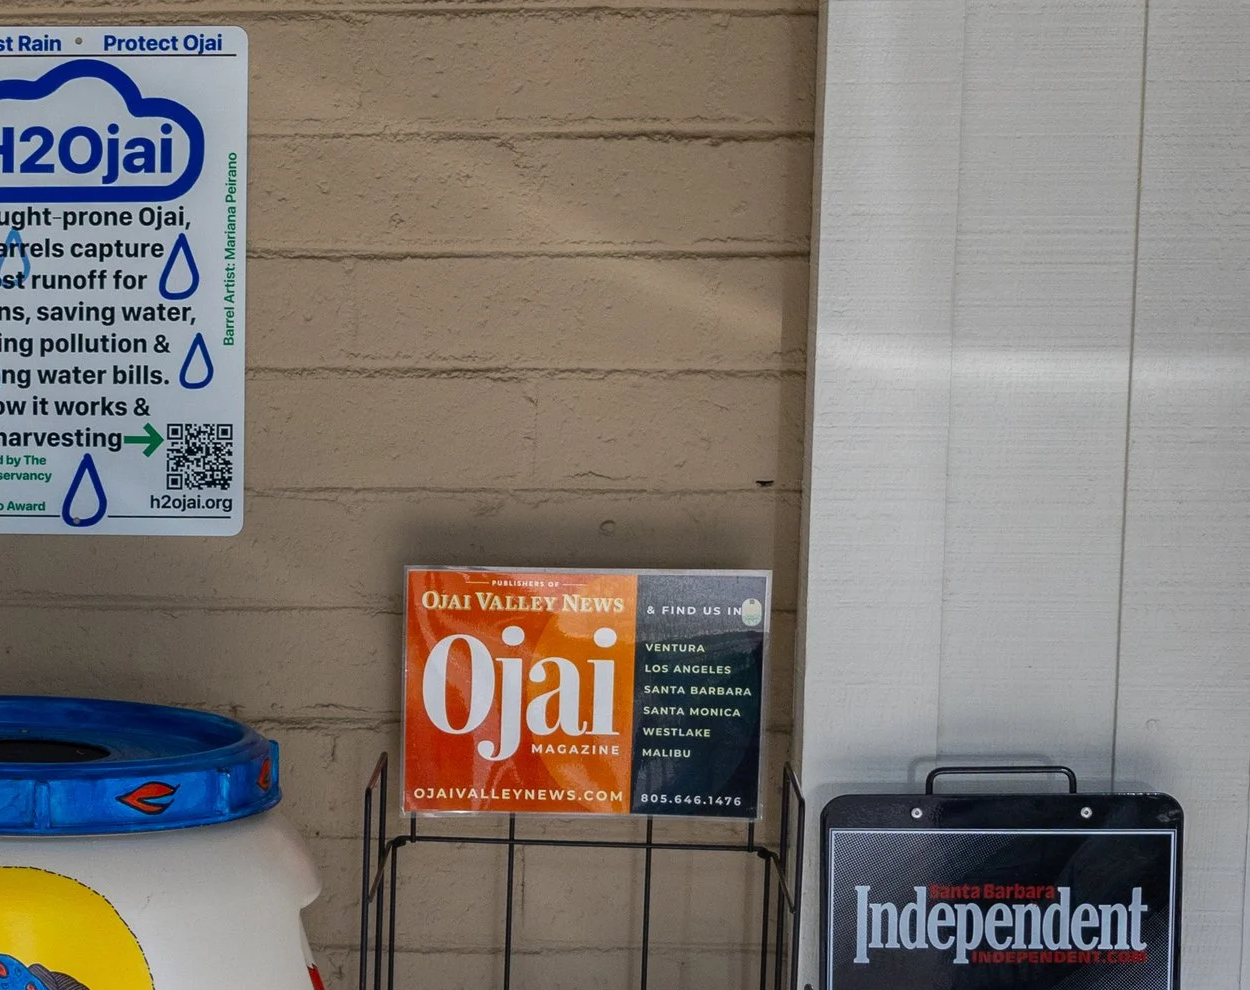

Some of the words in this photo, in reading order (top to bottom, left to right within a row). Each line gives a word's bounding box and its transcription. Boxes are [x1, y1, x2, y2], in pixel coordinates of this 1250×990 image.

[18, 36, 62, 52] Rain
[103, 35, 179, 51] Protect
[182, 34, 223, 54] Ojai
[225, 152, 238, 203] Peirano
[139, 206, 191, 231] Ojai,
[224, 206, 237, 260] Mariana
[70, 240, 164, 263] capture
[31, 270, 106, 289] runoff
[113, 270, 148, 289] for
[224, 263, 236, 304] Artist:
[36, 301, 116, 325] saving
[122, 304, 197, 325] water,
[223, 305, 235, 346] Barrel
[40, 333, 147, 357] pollution
[153, 334, 171, 353] &
[37, 367, 107, 385] water
[112, 364, 170, 385] bills.
[32, 396, 49, 416] it
[55, 396, 128, 416] works
[133, 397, 151, 417] &
[4, 454, 21, 468] by
[24, 455, 47, 466] The
[7, 501, 46, 512] Award
[150, 494, 233, 513] h2ojai.org
[491, 580, 545, 588] PUBLISHERS
[646, 605, 655, 615] &
[662, 606, 697, 616] FIND
[703, 606, 721, 616] US
[727, 607, 742, 616] IN
[645, 643, 705, 653] VENTURA
[644, 664, 669, 673] LOS
[673, 665, 732, 675] ANGELES
[422, 625, 620, 762] Ojai
[644, 685, 686, 695] SANTA
[690, 686, 752, 696] BARBARA
[643, 706, 685, 716] SANTA
[689, 707, 741, 717] MONICA
[642, 727, 711, 738] WESTLAKE
[531, 744, 620, 755] MAGAZINE
[642, 748, 691, 758] MALIBU
[413, 788, 623, 802] OJAIVALLEYNEWS.COM
[641, 794, 742, 806] 805.646.1476
[929, 883, 981, 900] Santa
[983, 884, 1056, 900] Barbara
[853, 885, 1149, 965] Independent
[971, 951, 1148, 964] INDEPENDENT.COM
